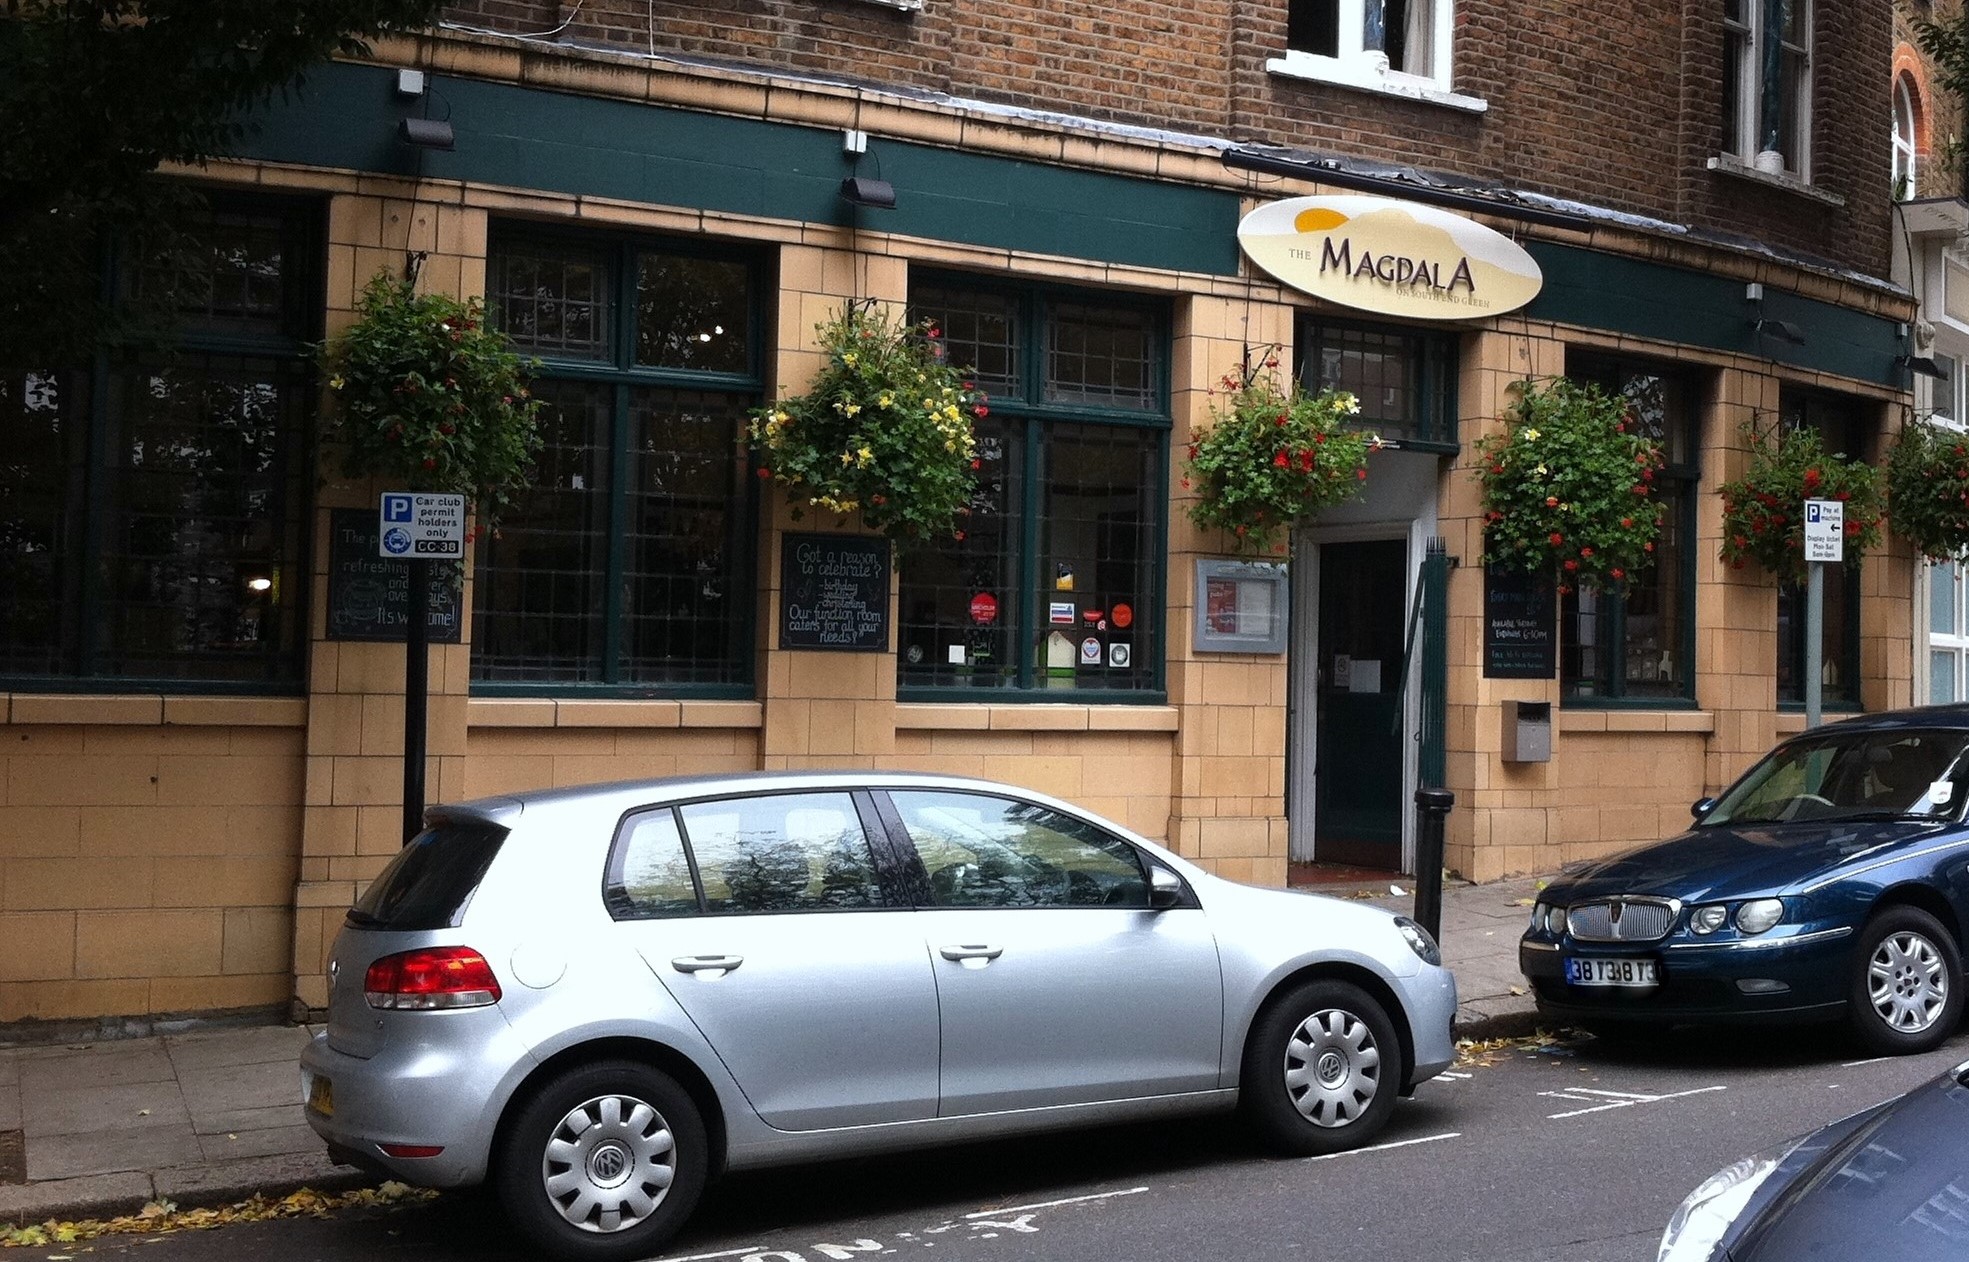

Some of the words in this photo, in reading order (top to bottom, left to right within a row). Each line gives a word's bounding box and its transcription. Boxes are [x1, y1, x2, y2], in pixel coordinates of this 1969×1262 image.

[1288, 248, 1312, 261] THE
[1319, 236, 1475, 292] MAGDALA
[1396, 287, 1409, 298] ON
[1411, 289, 1439, 302] SOUTH
[1441, 294, 1460, 304] END
[1461, 296, 1490, 308] GREEN
[390, 498, 409, 520] P
[415, 496, 435, 506] Car
[438, 497, 461, 506] club
[420, 508, 455, 517] permit
[1809, 505, 1818, 521] P
[418, 518, 458, 527] holders
[342, 528, 365, 544] The
[426, 529, 449, 539] only
[796, 542, 822, 563] Got
[827, 553, 835, 563] a
[840, 552, 878, 564] reason
[342, 559, 409, 580] refreshing
[802, 562, 814, 575] to
[789, 603, 812, 619] Our
[813, 604, 853, 621] function
[856, 608, 882, 622] room
[789, 619, 821, 632] caters
[824, 619, 839, 634] for
[841, 617, 855, 632] all
[858, 622, 879, 638] your
